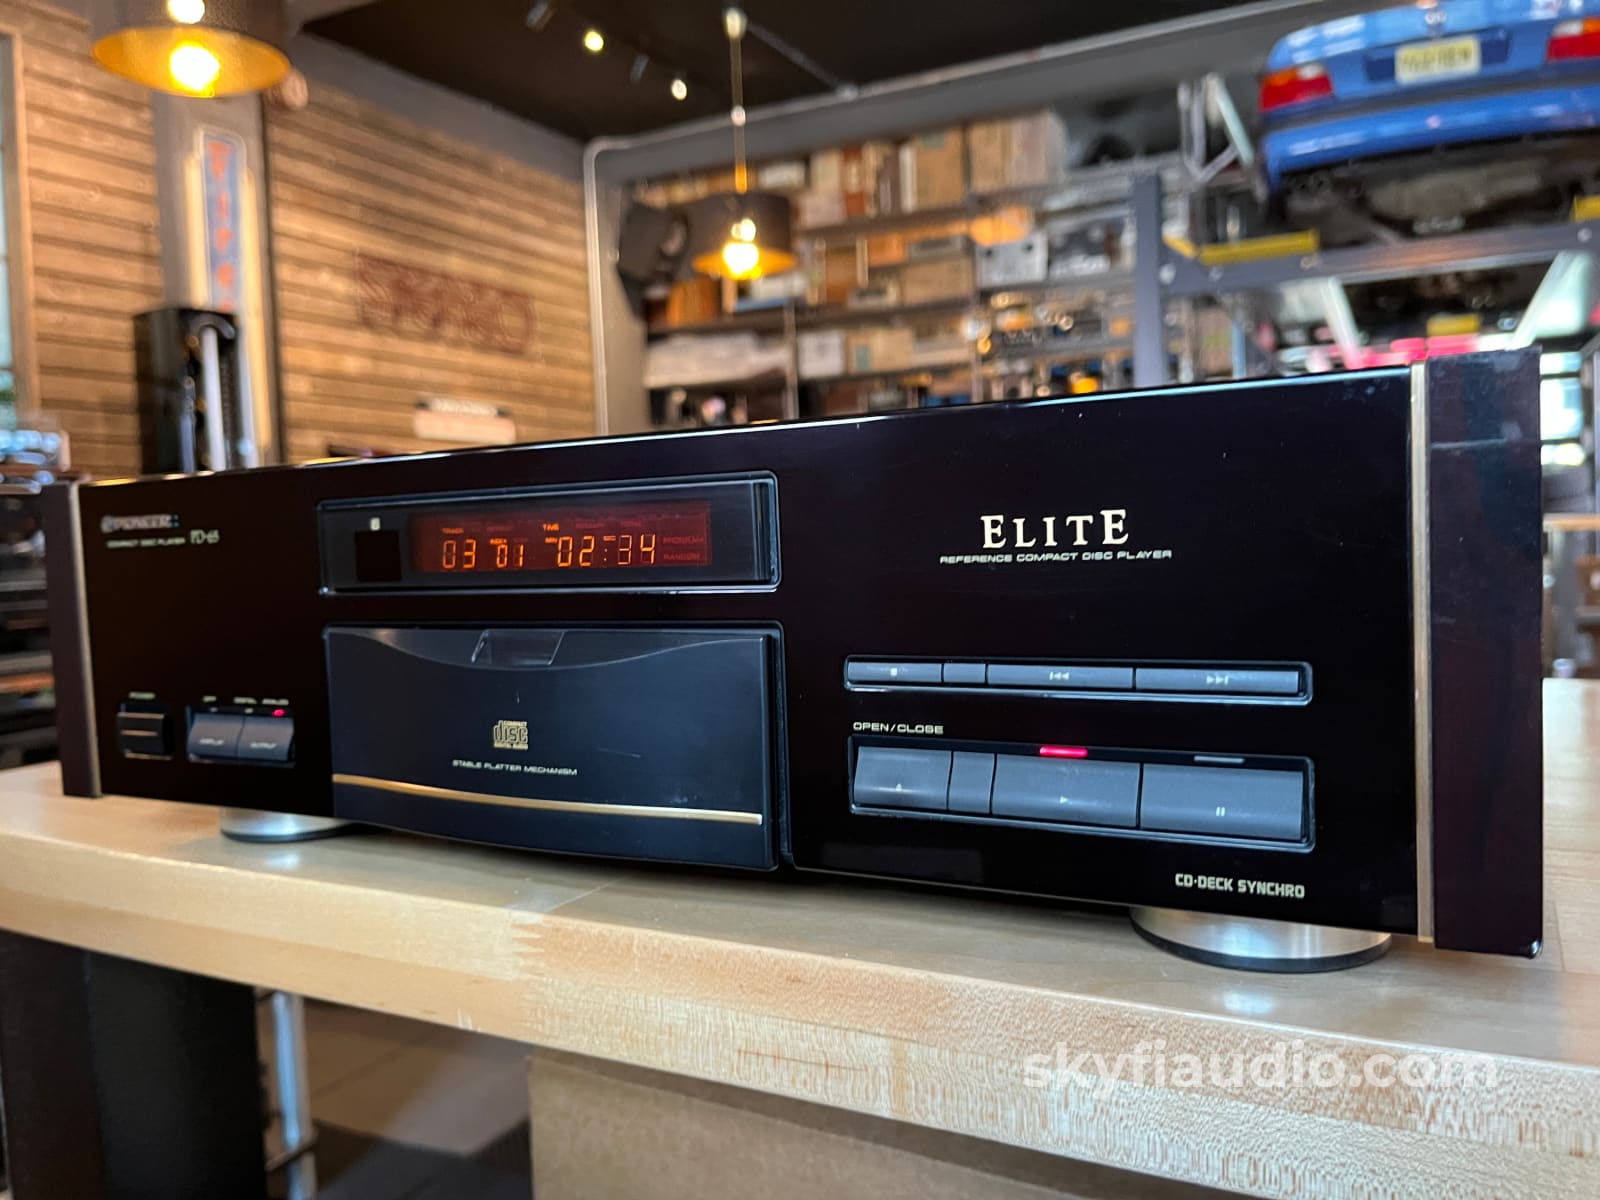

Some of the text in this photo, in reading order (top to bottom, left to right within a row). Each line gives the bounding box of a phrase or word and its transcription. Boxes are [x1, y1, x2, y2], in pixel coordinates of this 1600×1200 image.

[980, 509, 1129, 548] ELITE
[443, 539, 476, 569] 03
[496, 544, 524, 568] 01
[939, 549, 1172, 564] REFERENCE COMPACT DISC PLAYER
[853, 721, 944, 735] OPEN/CLOSE
[452, 759, 578, 776] STABLE PLATTER MECHANISM
[1237, 879, 1305, 899] SYNCHRO
